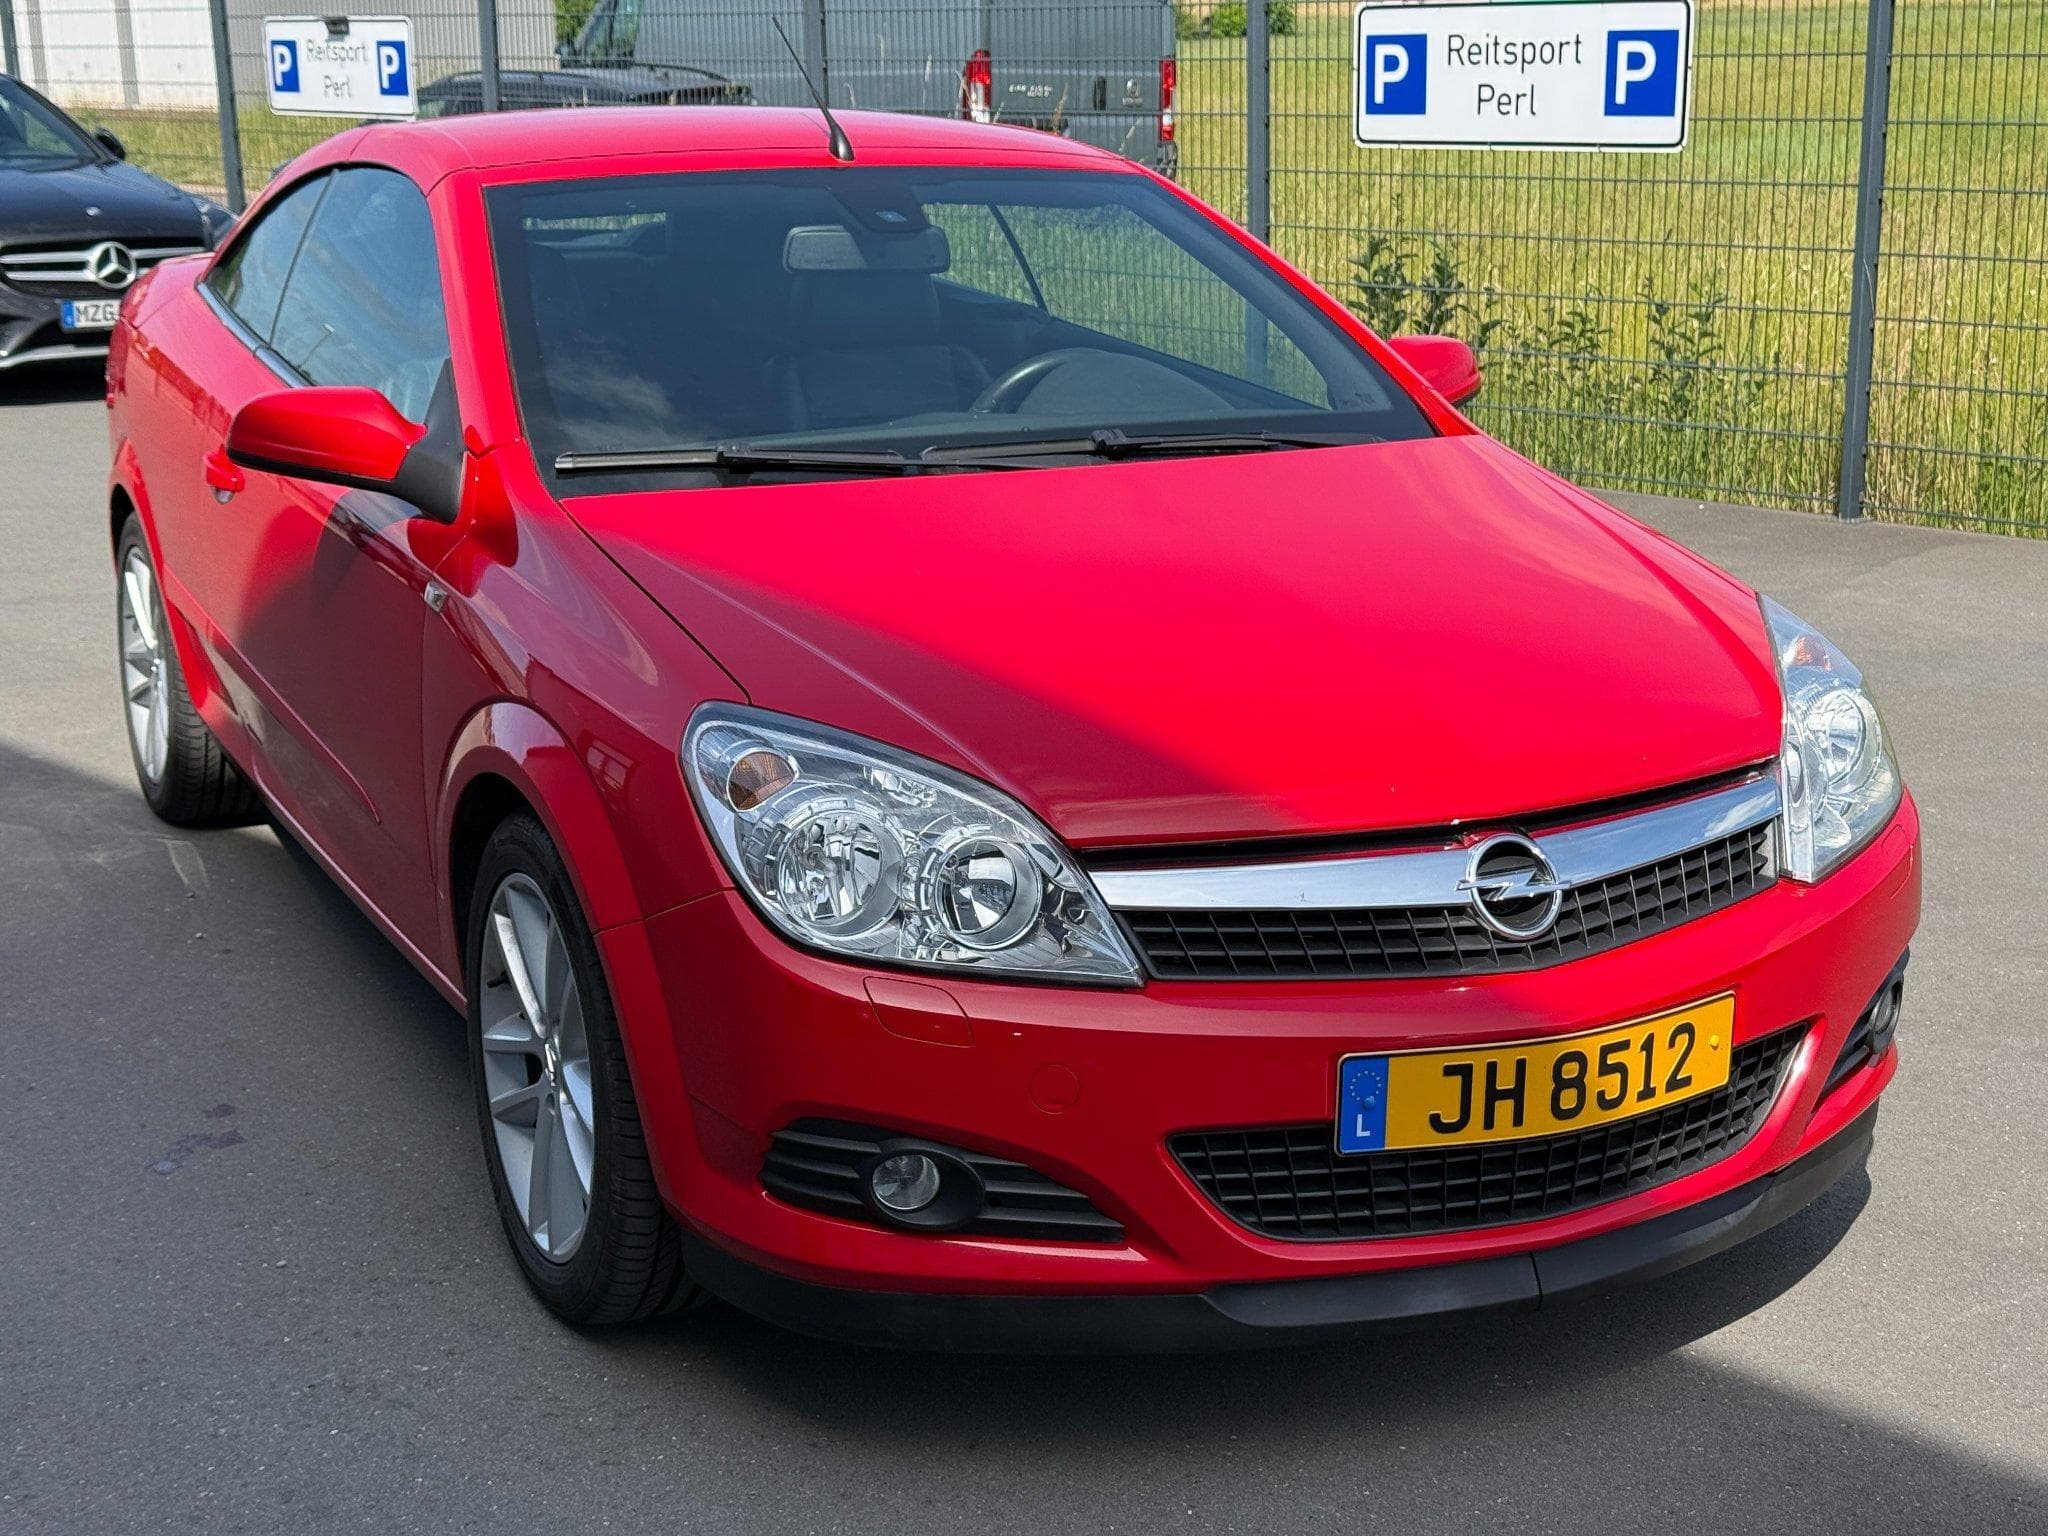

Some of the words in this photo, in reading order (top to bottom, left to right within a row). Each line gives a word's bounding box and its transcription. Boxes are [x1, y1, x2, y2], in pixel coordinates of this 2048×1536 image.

[272, 44, 292, 87] P
[305, 38, 369, 68] Reitsport
[379, 45, 400, 90] P
[1447, 33, 1583, 74] Reitsport
[1614, 40, 1657, 105] P
[322, 74, 351, 99] Perl
[1373, 43, 1410, 105] P
[1476, 83, 1537, 117] Perl
[75, 303, 115, 323] MZG
[1428, 1056, 1527, 1135] JH
[1550, 1021, 1697, 1122] 8512
[1356, 1113, 1371, 1138] L
